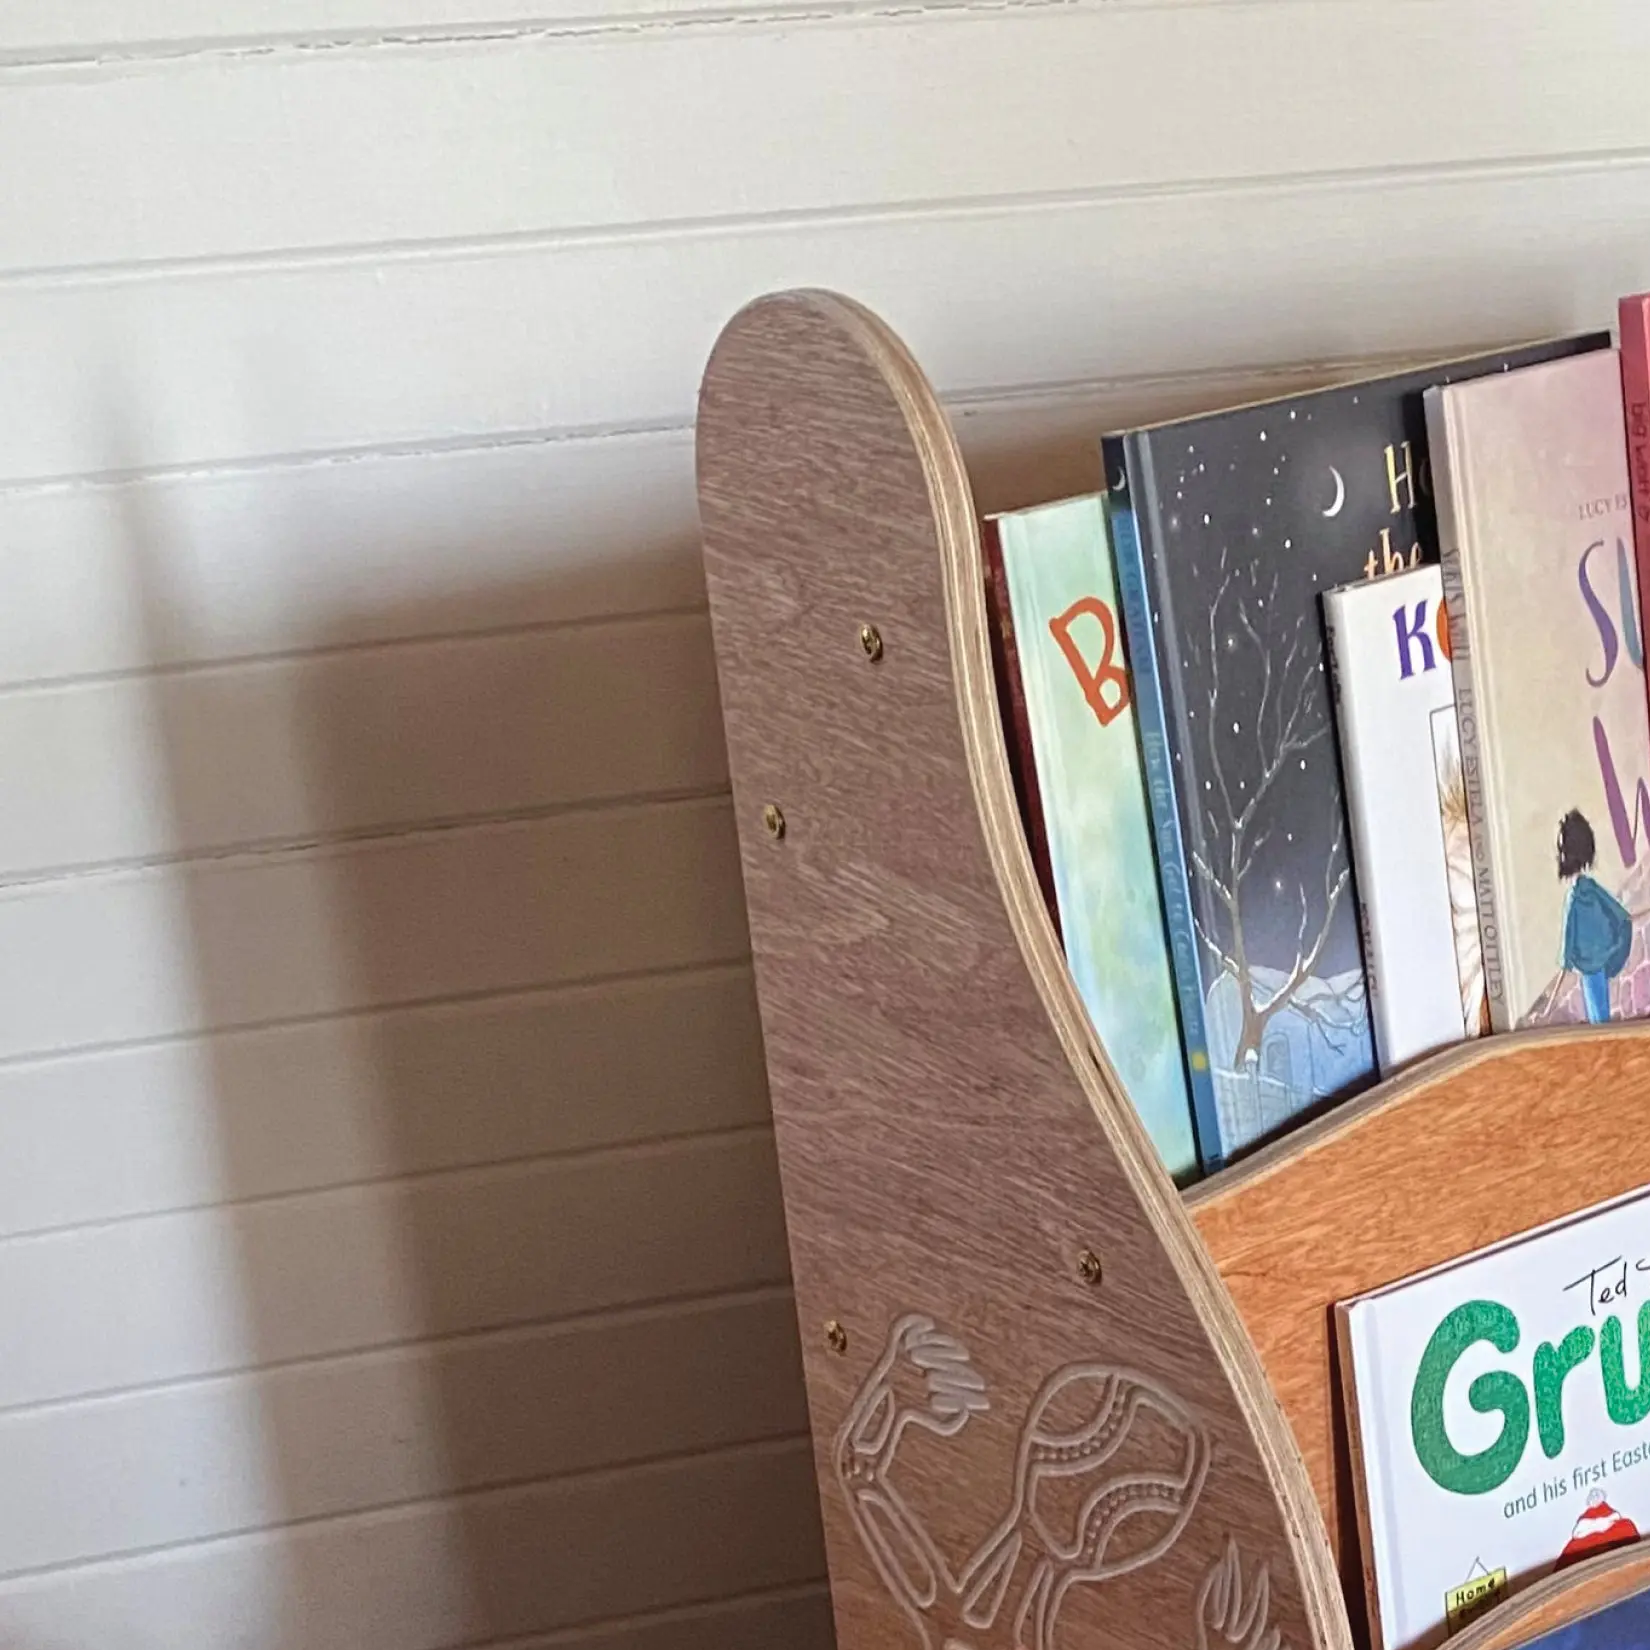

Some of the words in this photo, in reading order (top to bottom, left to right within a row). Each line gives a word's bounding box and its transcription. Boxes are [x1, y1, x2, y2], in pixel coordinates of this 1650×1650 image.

[1578, 498, 1612, 520] LUCY
[1457, 687, 1477, 749] LUCY
[1464, 755, 1486, 826] ESTELA
[1476, 867, 1496, 919] MATT
[1563, 1255, 1628, 1316] Ted
[1503, 1482, 1538, 1520] and
[1543, 1471, 1568, 1503] his
[1572, 1456, 1608, 1491] first
